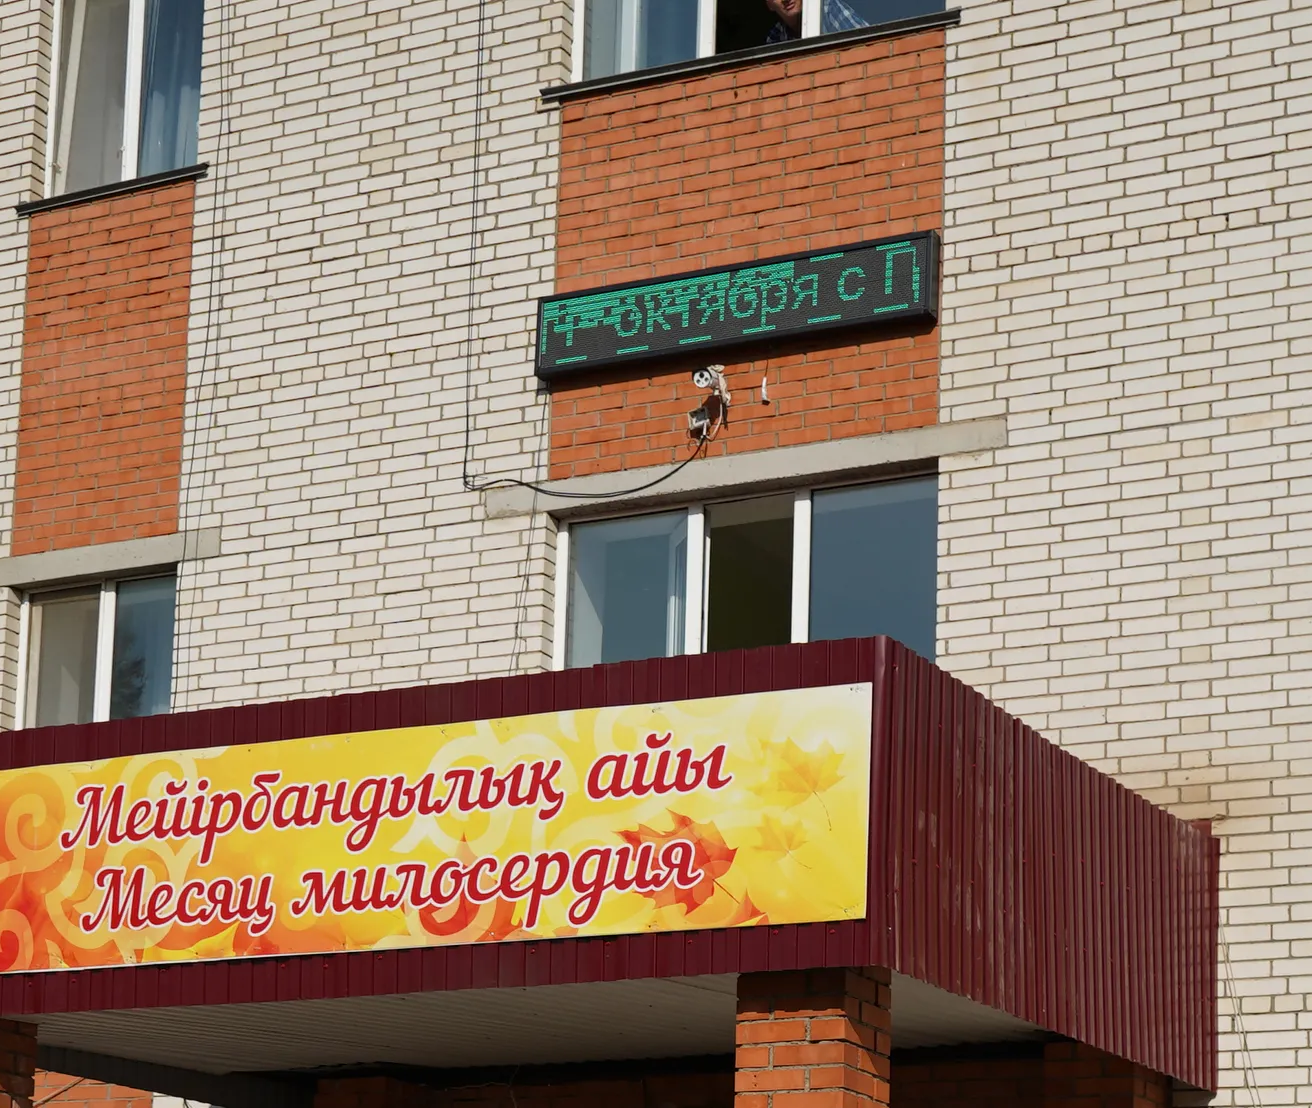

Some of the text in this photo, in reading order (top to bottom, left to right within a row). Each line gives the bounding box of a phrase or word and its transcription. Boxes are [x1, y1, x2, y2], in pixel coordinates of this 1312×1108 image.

[60, 732, 732, 866] Мейірбандылық айы
[80, 842, 702, 938] Месяц милосердия
